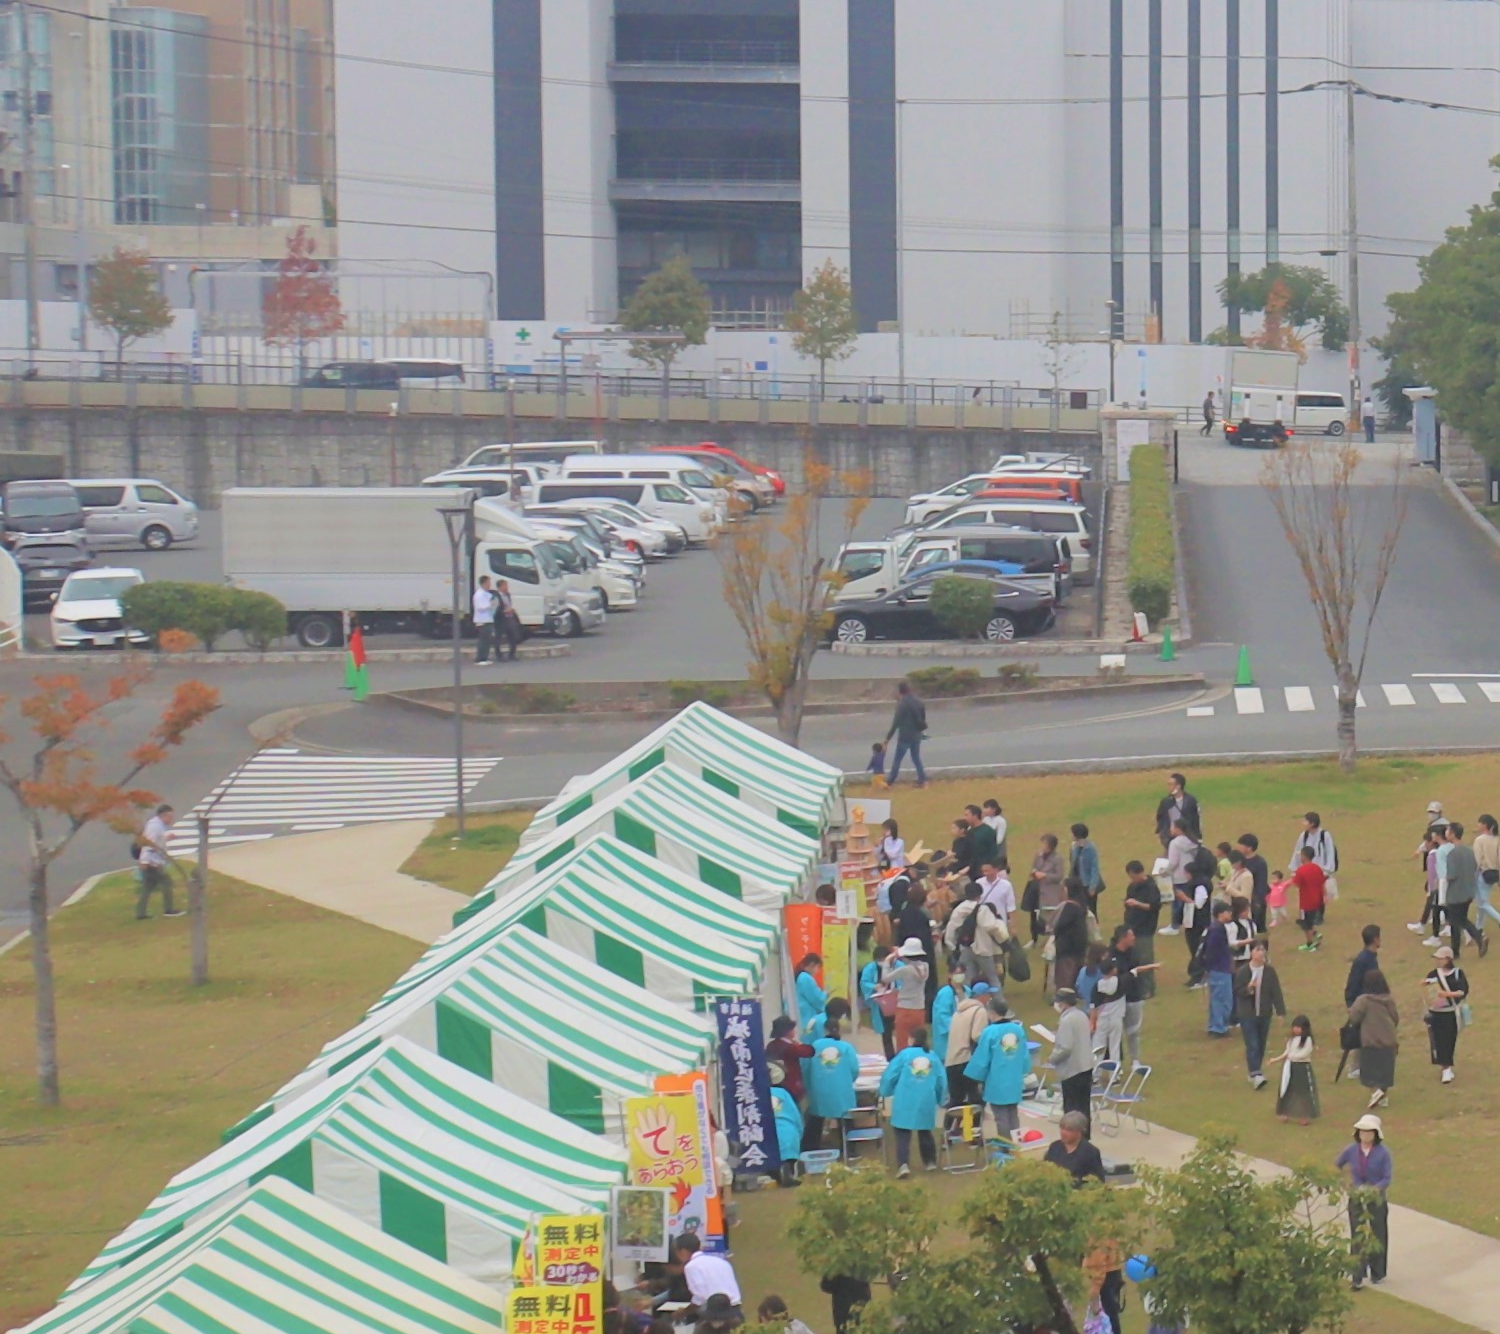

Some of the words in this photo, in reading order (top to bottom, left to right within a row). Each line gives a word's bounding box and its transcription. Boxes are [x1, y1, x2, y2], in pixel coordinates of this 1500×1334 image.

[637, 1153, 699, 1184] あらおう
[543, 1222, 599, 1245] 無料
[544, 1244, 599, 1262] 測定中
[513, 1294, 571, 1318] 無料
[514, 1319, 570, 1334] 測定中
